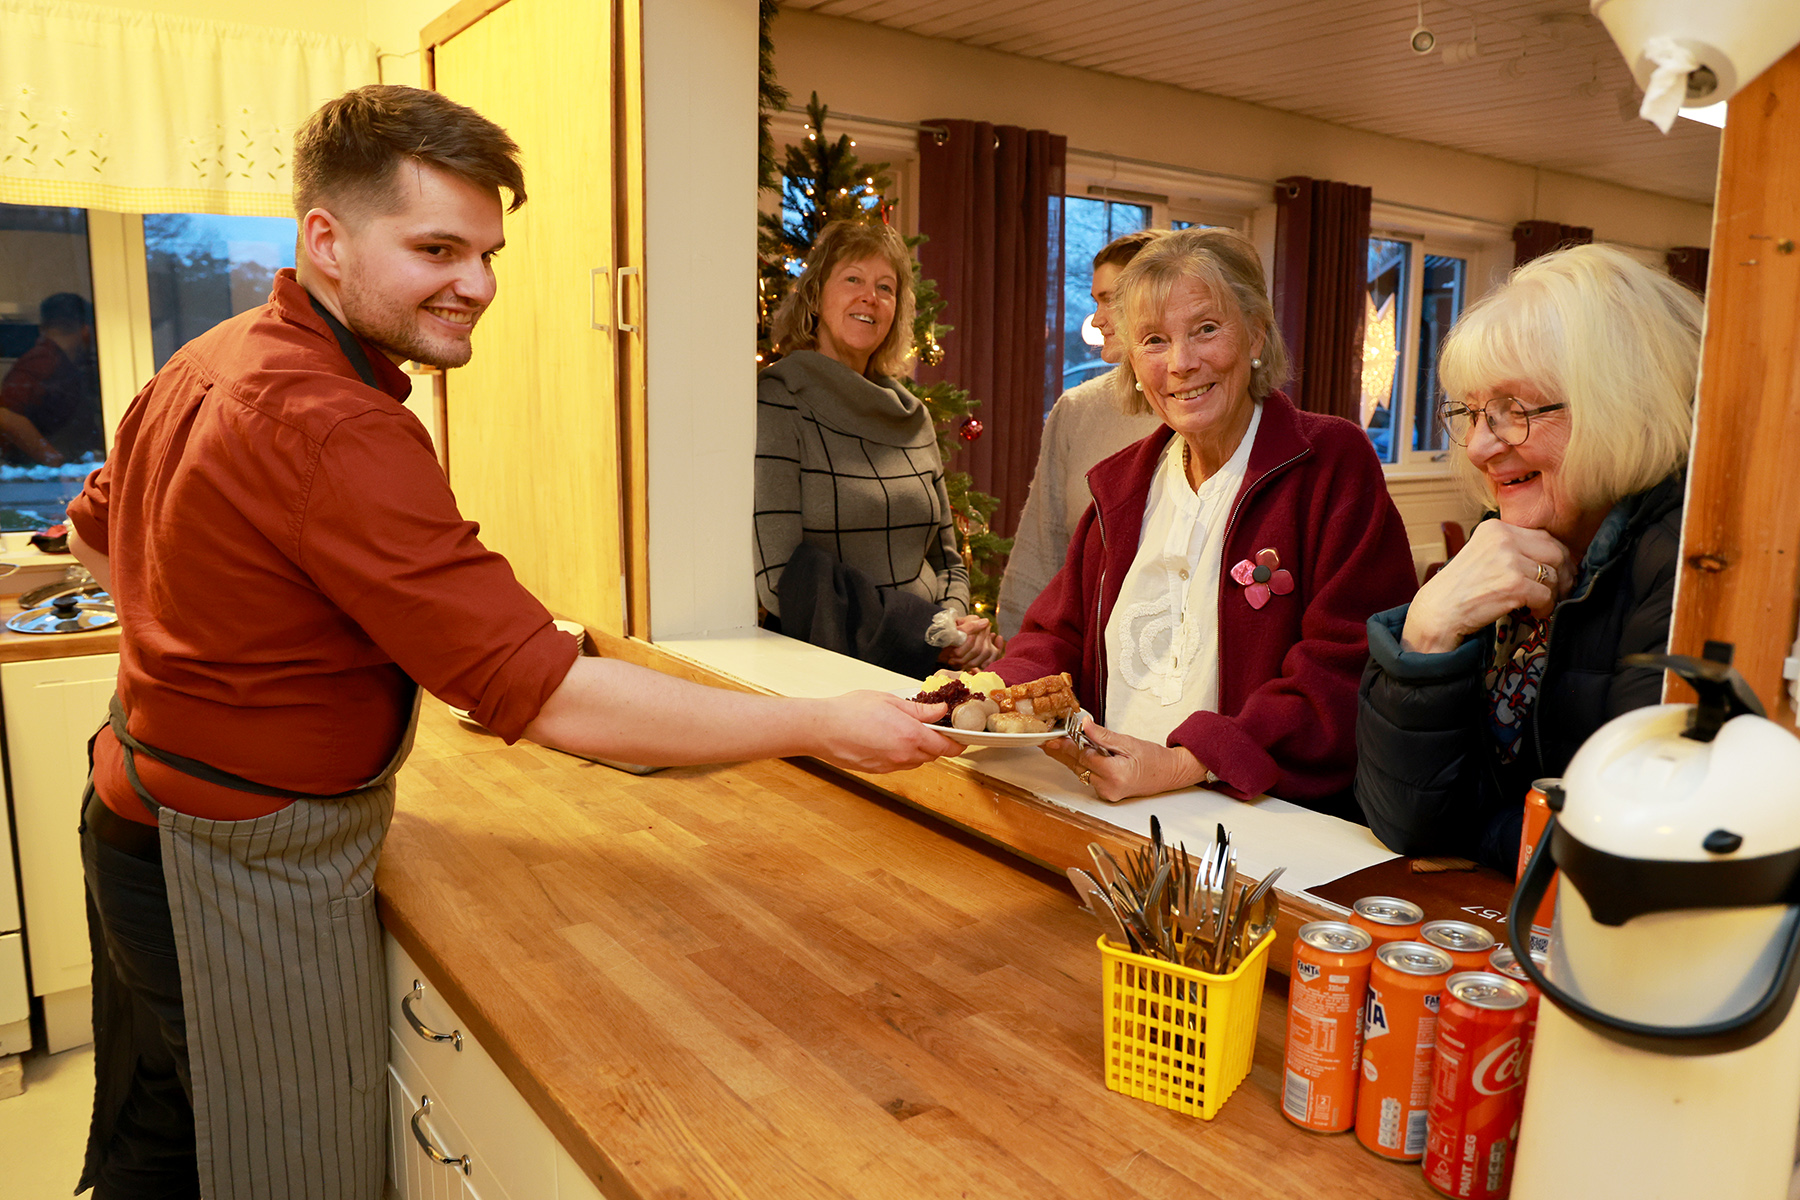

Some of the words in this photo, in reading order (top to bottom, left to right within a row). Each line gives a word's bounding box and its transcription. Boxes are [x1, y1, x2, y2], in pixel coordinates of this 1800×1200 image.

[1297, 959, 1320, 976] FANTA
[1355, 1006, 1364, 1035] MEG
[1351, 1039, 1361, 1070] PANT
[1463, 1134, 1477, 1162] MEG
[1459, 1164, 1473, 1197] PANT
